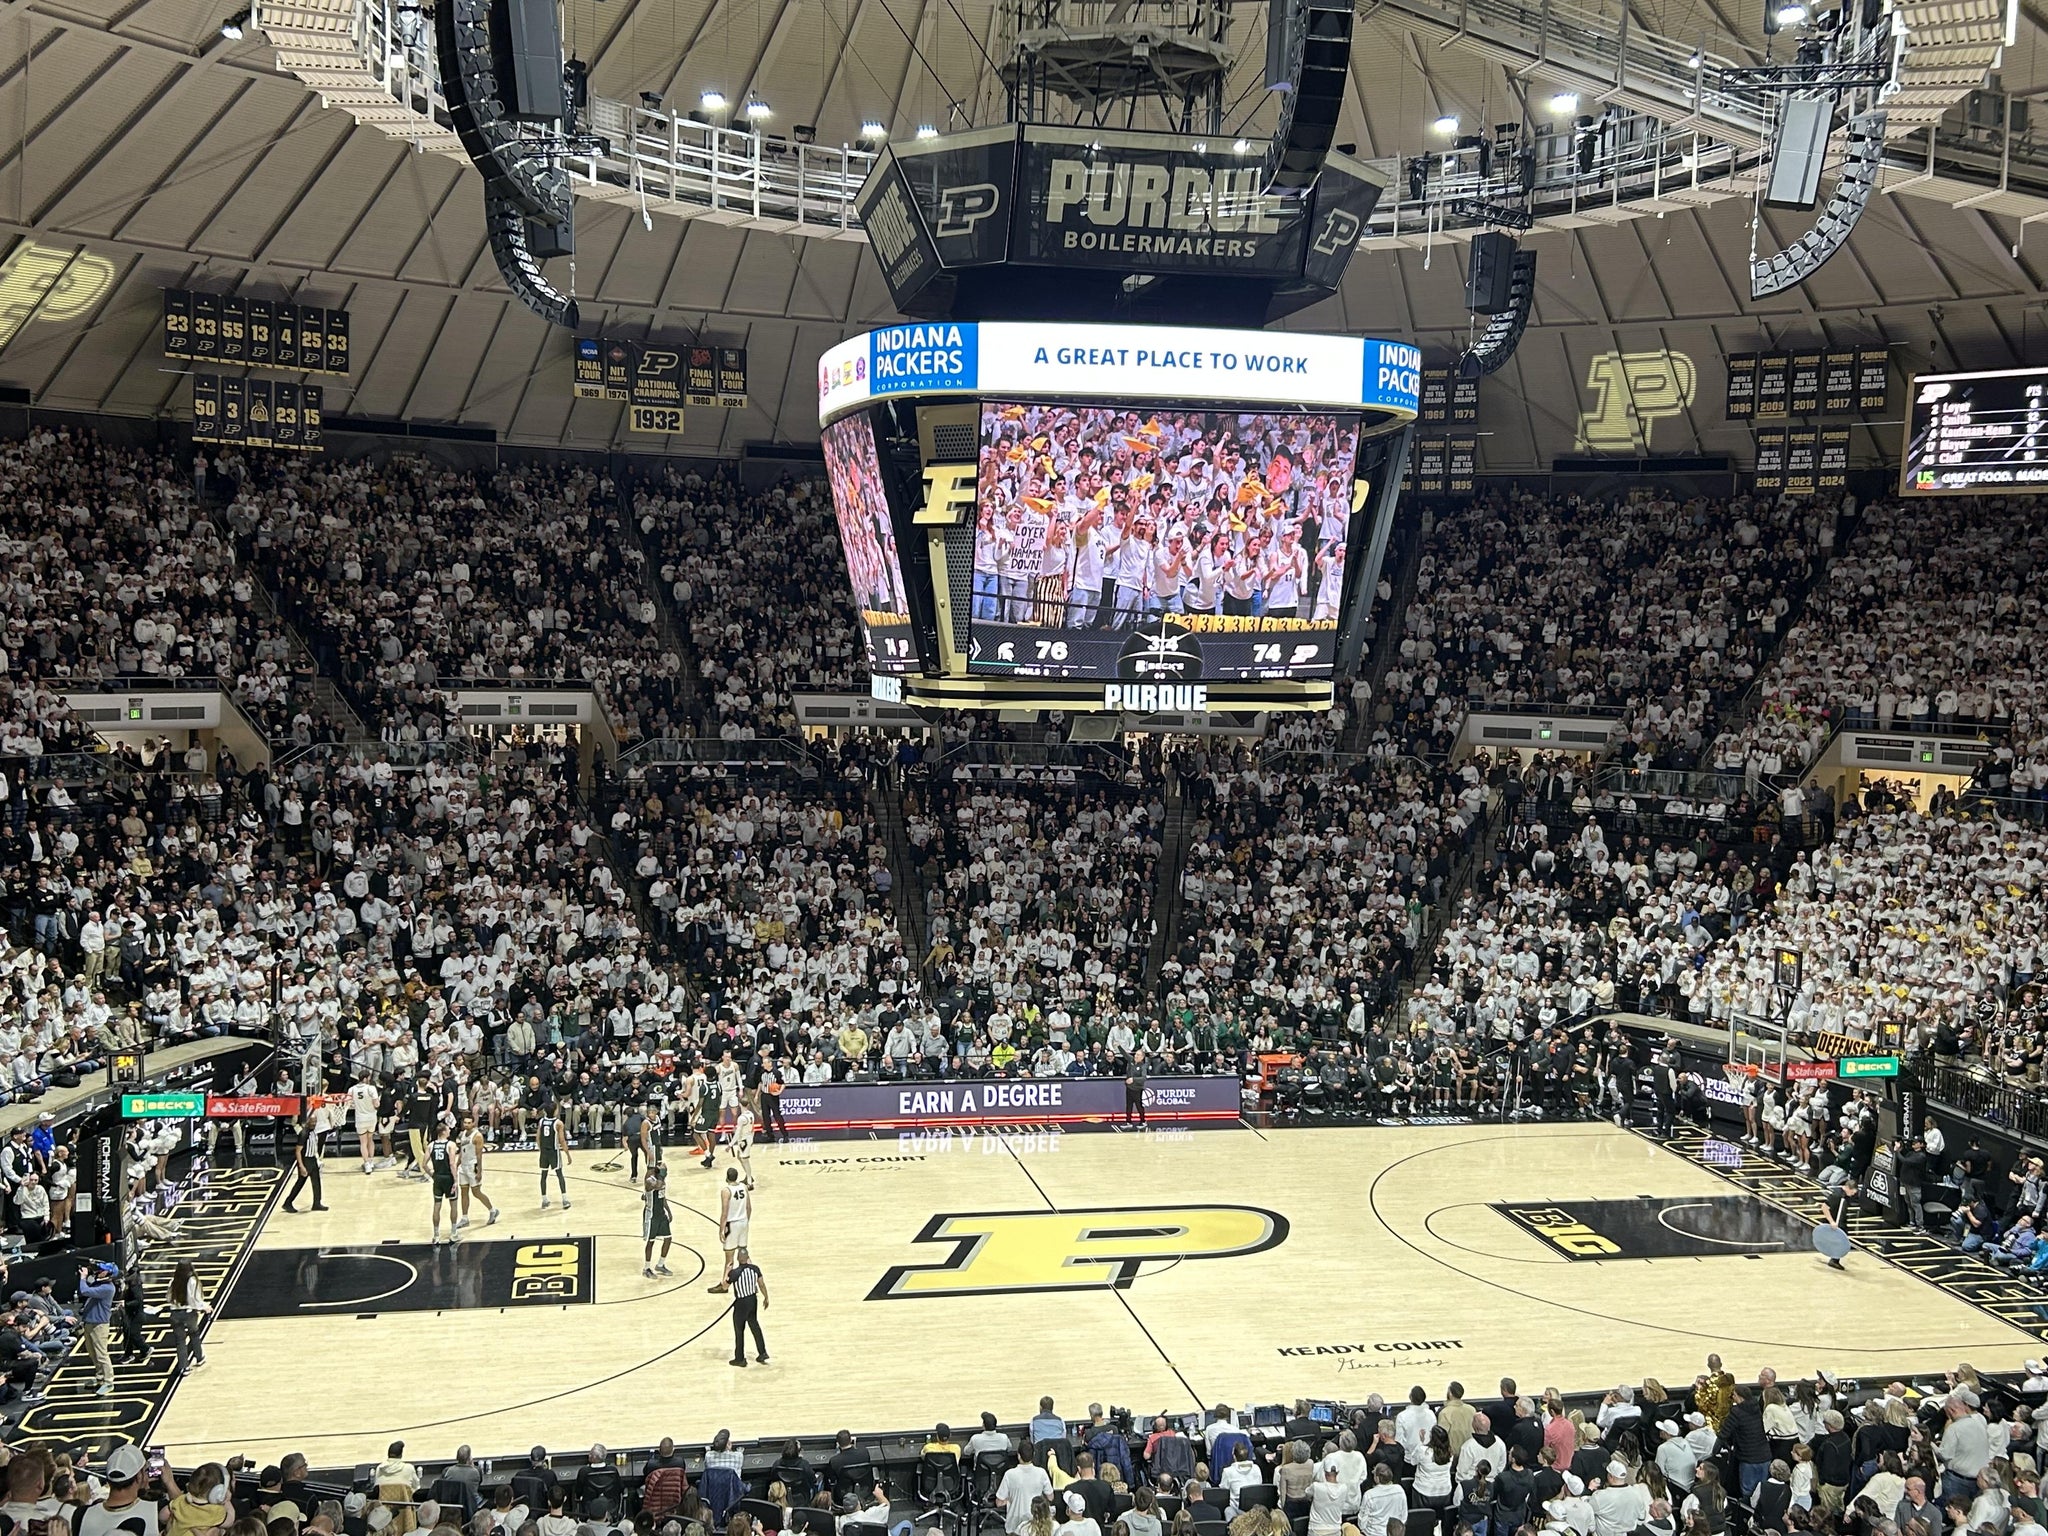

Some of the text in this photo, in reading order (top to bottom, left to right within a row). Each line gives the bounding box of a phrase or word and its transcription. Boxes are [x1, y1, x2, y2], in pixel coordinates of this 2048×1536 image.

[1045, 158, 1283, 235] PURDUE
[866, 180, 918, 272] PURDUE
[1063, 231, 1257, 258] BOILERMAKERS
[166, 314, 189, 332] 23
[195, 318, 217, 336] 33
[222, 321, 243, 339] 55
[251, 325, 269, 342] 13
[281, 328, 292, 344] 4
[302, 331, 321, 348] 25
[328, 335, 347, 351] 33
[876, 325, 963, 353] INDIANA
[577, 360, 602, 371] FINAL
[876, 350, 963, 379] PACKERS
[1034, 346, 1309, 375] A GREAT PLACE TO WORK
[579, 369, 601, 380] FOUR
[609, 366, 625, 377] NIT
[689, 368, 713, 379] FINAL
[720, 371, 745, 381] FINAL
[637, 379, 677, 391] NATIONAL
[691, 377, 712, 388] FOUR
[722, 379, 744, 390] FOUR
[876, 379, 963, 392] CORPORATION
[581, 388, 599, 397] 1969
[608, 390, 627, 399] 1974
[633, 388, 680, 399] CHAMPIONS
[194, 399, 216, 416] 50
[722, 398, 743, 408] 2024
[1942, 402, 1971, 415] Loyer
[227, 402, 238, 418] 3
[276, 407, 296, 424] 23
[303, 409, 320, 424] 15
[634, 409, 680, 431] 1932
[1941, 415, 1971, 426] Smith
[1941, 472, 1977, 484] GREAT
[1015, 526, 1045, 539] LOYER
[1020, 538, 1035, 548] UP
[1011, 548, 1043, 560] HAMMER
[1035, 640, 1069, 660] 76
[1253, 643, 1282, 662] 74
[1105, 683, 1208, 711] PURDUE
[357, 1092, 364, 1100] 5
[711, 1089, 717, 1100] 3
[900, 1083, 1062, 1114] EARN A DEGREE
[1156, 1088, 1196, 1098] PURDUE
[147, 1101, 195, 1110] BECK'S
[779, 1097, 822, 1108] PURDUE
[543, 1127, 550, 1137] 6
[434, 1149, 445, 1160] 15
[779, 1155, 927, 1166] KEADY COURT
[100, 1136, 112, 1201] ROHRMAN
[733, 1189, 745, 1200] 45
[1277, 1339, 1465, 1357] KEADY COURT
